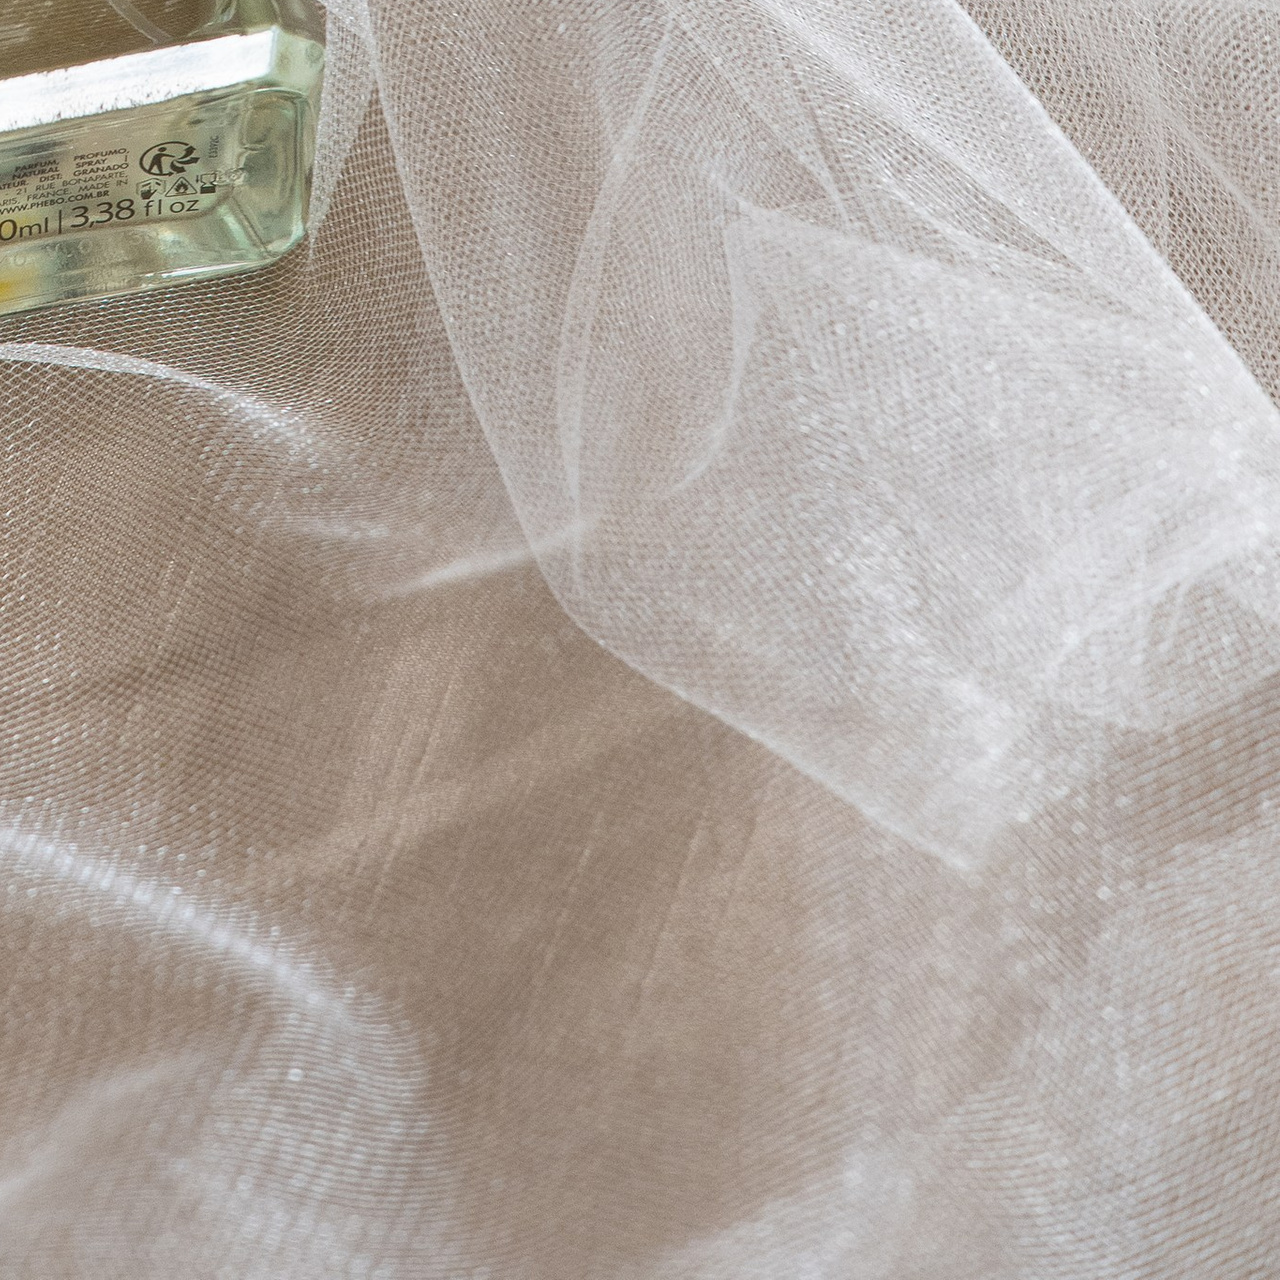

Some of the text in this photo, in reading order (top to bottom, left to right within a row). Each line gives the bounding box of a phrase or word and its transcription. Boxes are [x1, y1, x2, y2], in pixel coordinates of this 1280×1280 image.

[12, 167, 60, 180] NATURAL
[75, 158, 107, 169] SPRAY
[73, 163, 129, 177] GRANADO
[16, 188, 27, 196] 21
[36, 182, 56, 192] RUE
[78, 182, 110, 193] MADE
[116, 178, 128, 187] IN
[70, 198, 135, 228] 3,38
[170, 200, 199, 214] oz
